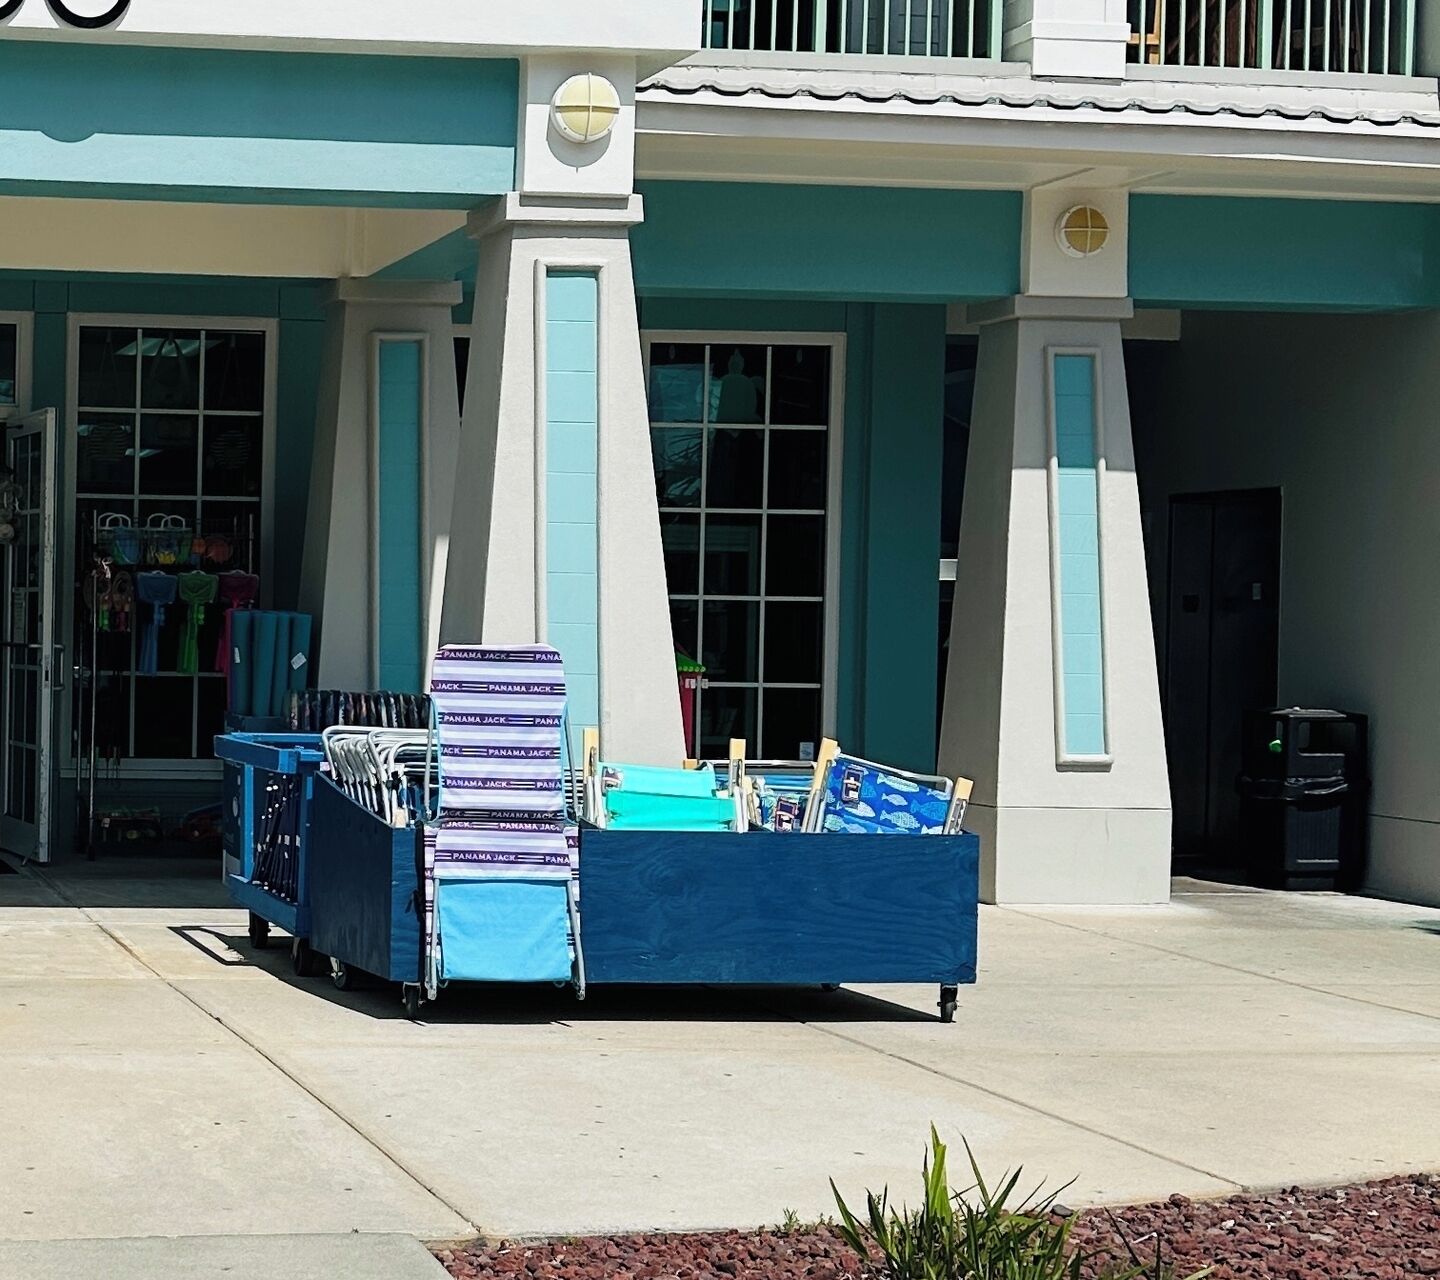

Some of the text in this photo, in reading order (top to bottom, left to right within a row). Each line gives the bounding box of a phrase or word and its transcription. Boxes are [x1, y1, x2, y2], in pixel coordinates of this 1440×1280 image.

[443, 649, 508, 660] PANAMA JACK
[436, 682, 460, 690] JACK
[488, 684, 552, 693] PANAMA JACK
[443, 715, 507, 724] PANAMA JACK
[488, 748, 552, 758] PANAMA JACK
[446, 778, 509, 788] PANAMA JACK
[491, 811, 556, 820] PANAMA JACK
[499, 822, 539, 830] PANAMA
[453, 853, 517, 862] PANAMA JACK
